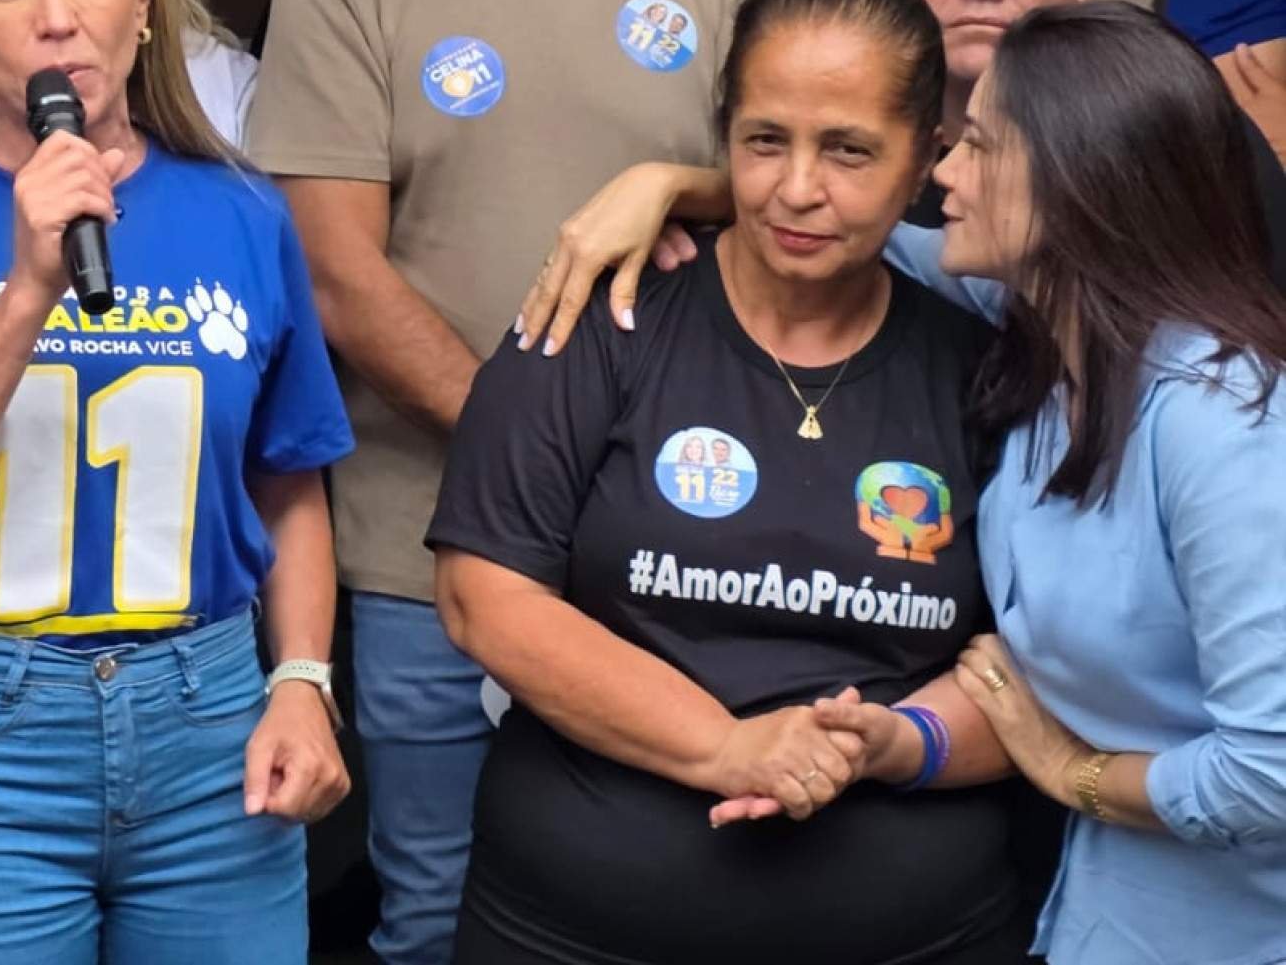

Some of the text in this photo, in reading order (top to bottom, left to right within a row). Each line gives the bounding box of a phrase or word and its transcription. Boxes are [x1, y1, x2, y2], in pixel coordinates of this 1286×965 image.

[69, 339, 143, 355] ROCHA
[146, 340, 194, 356] VICE
[629, 549, 957, 630] #AmorAoPróximo
